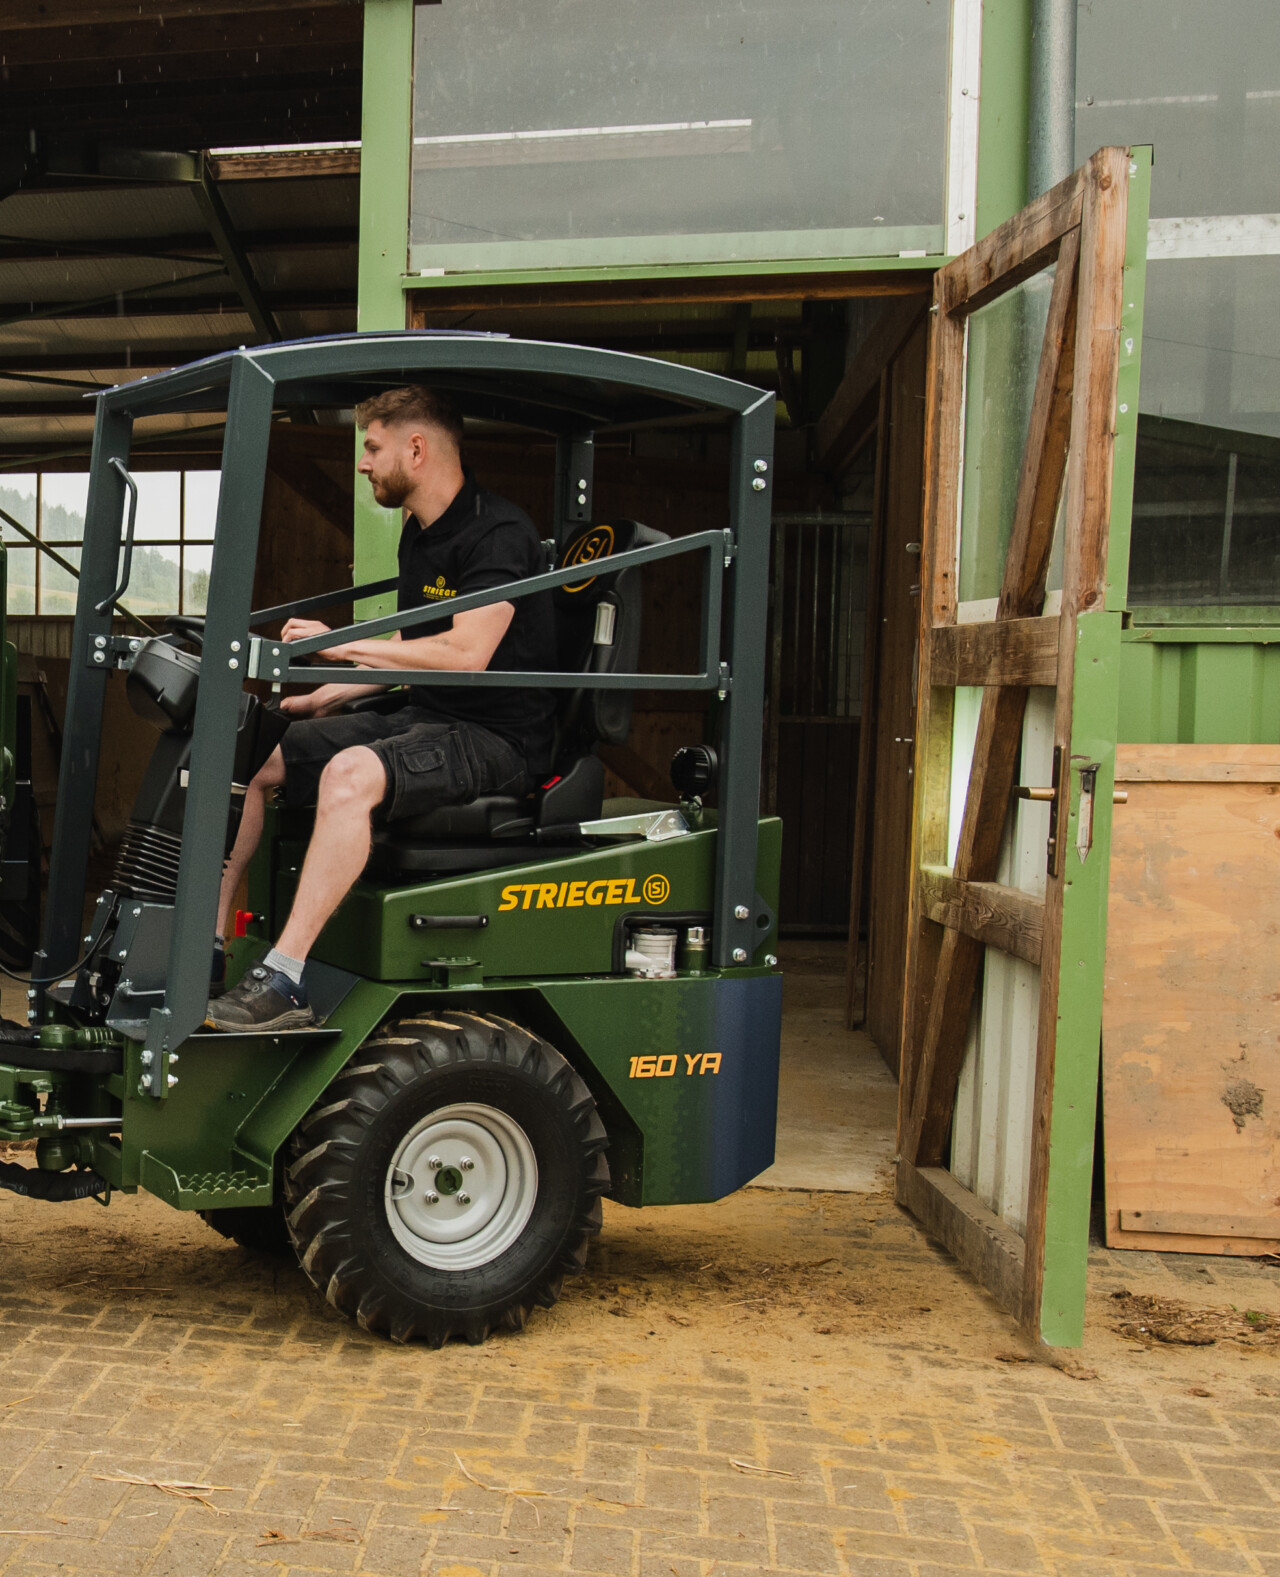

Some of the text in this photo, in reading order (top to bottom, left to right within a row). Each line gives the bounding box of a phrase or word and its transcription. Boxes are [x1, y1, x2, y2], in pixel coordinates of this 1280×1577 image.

[423, 585, 457, 597] STRIEGE
[498, 878, 641, 911] STRIEGEL
[629, 1053, 722, 1078] 160 YA
